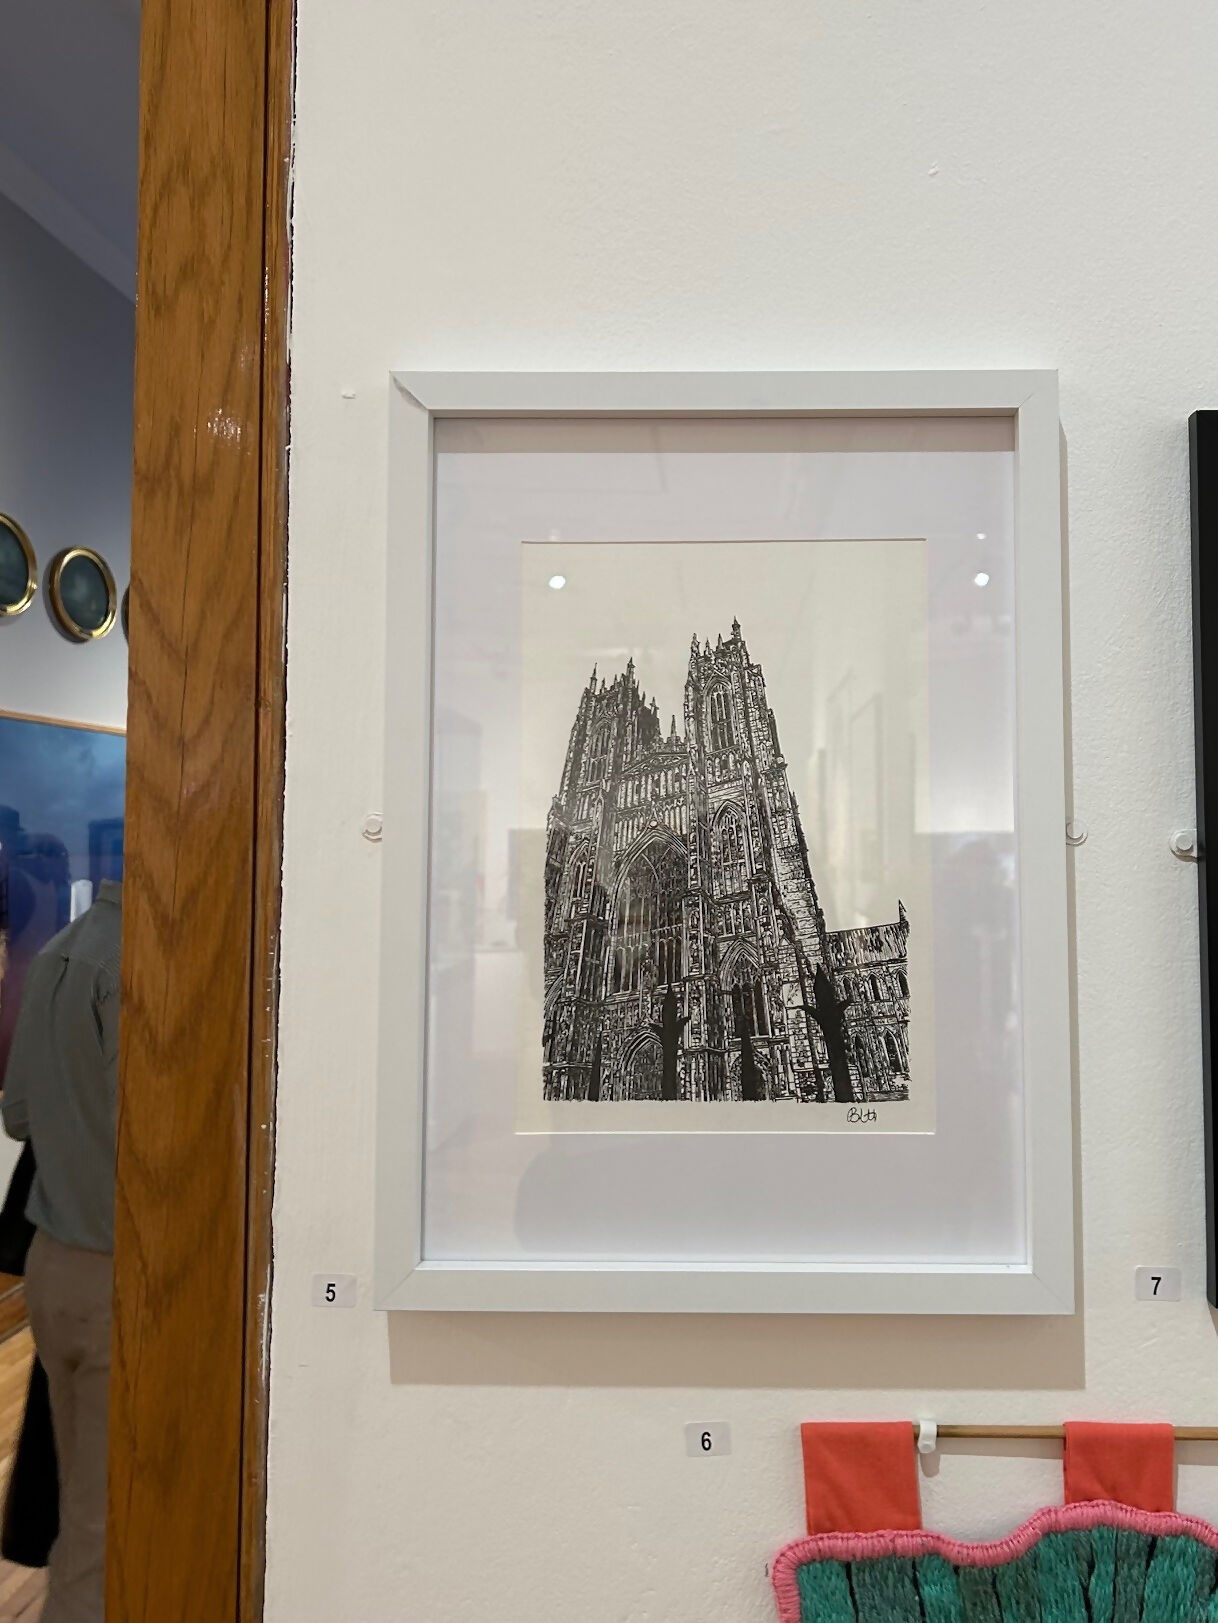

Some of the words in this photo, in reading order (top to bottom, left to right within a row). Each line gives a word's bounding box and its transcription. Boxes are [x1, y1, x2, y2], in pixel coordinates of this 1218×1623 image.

[325, 1283, 336, 1303] 5
[1150, 1276, 1162, 1296] 7
[701, 1431, 713, 1452] 6
